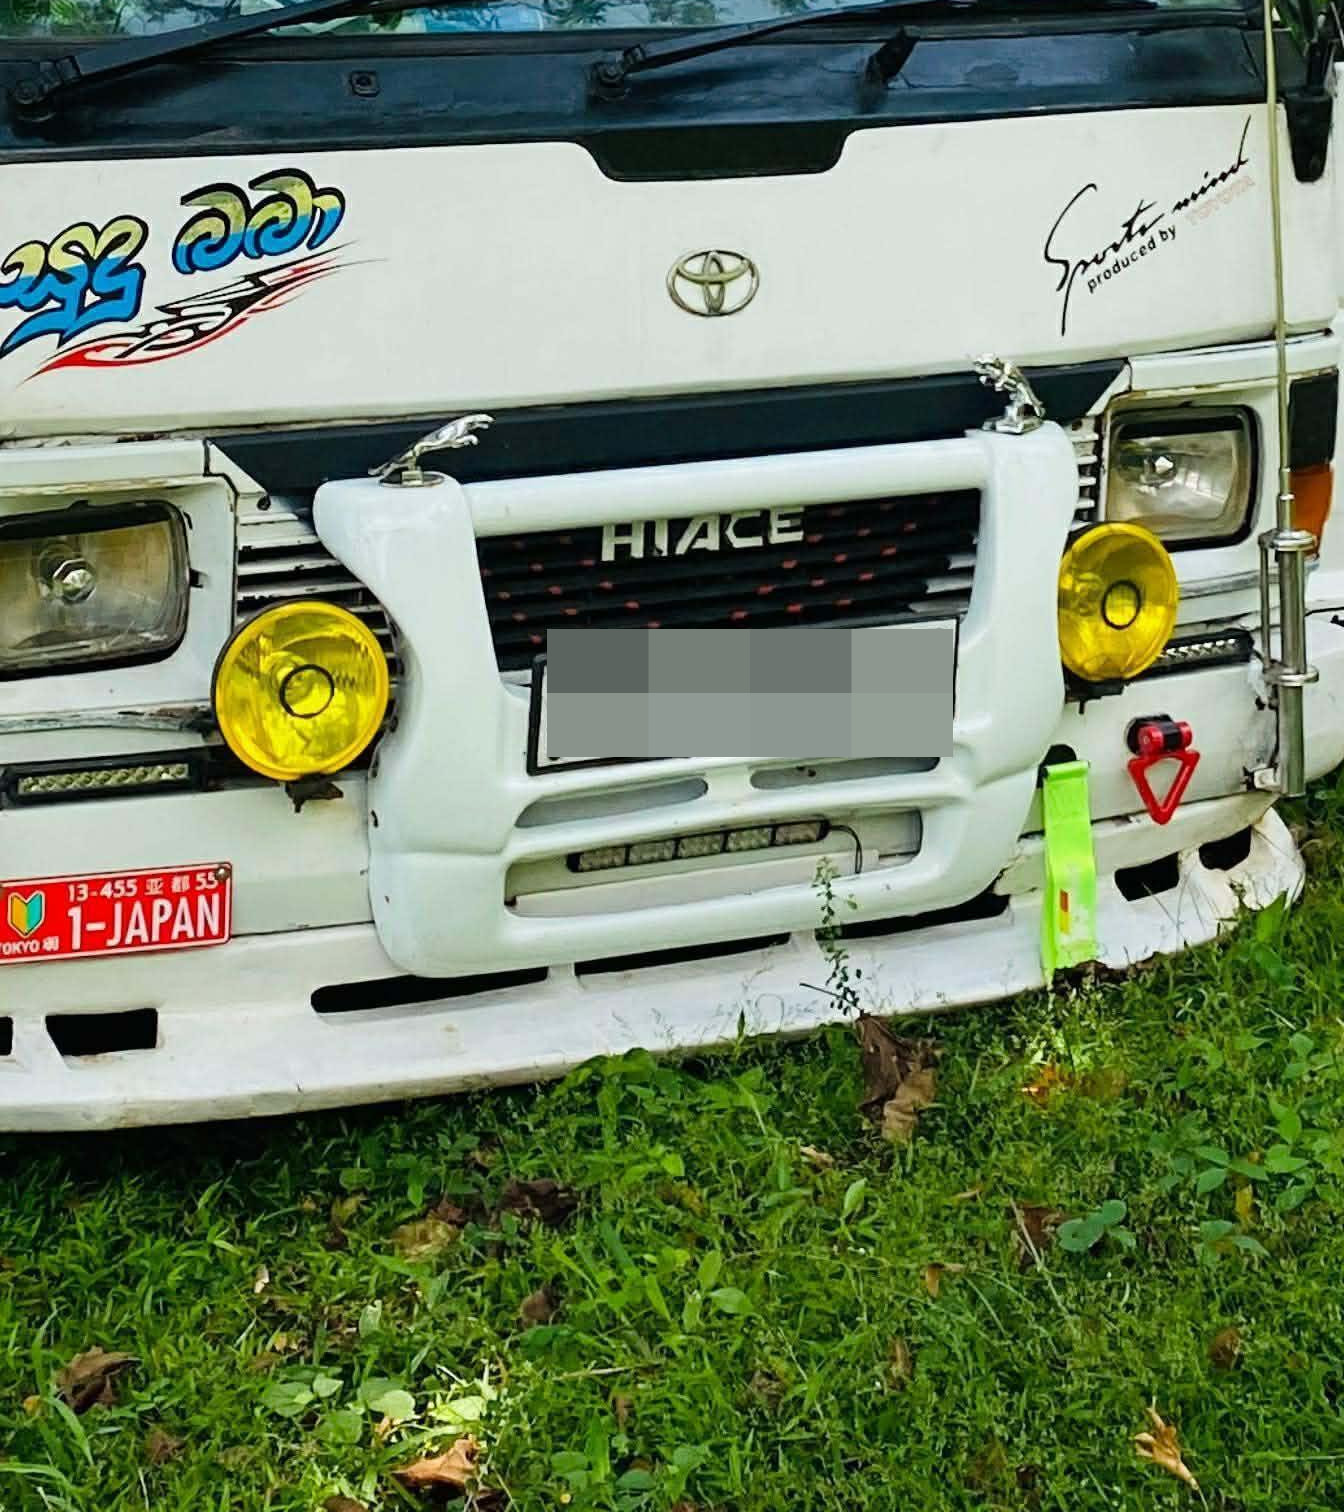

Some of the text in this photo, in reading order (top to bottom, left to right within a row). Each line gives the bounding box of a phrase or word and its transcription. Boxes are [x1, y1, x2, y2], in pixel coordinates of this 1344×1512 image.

[1045, 115, 1252, 336] Sports mind
[1087, 234, 1156, 294] produced
[1159, 225, 1177, 242] by
[601, 505, 805, 562] HIACE
[68, 878, 138, 903] 13-455
[67, 892, 220, 951] 1-JAPAN
